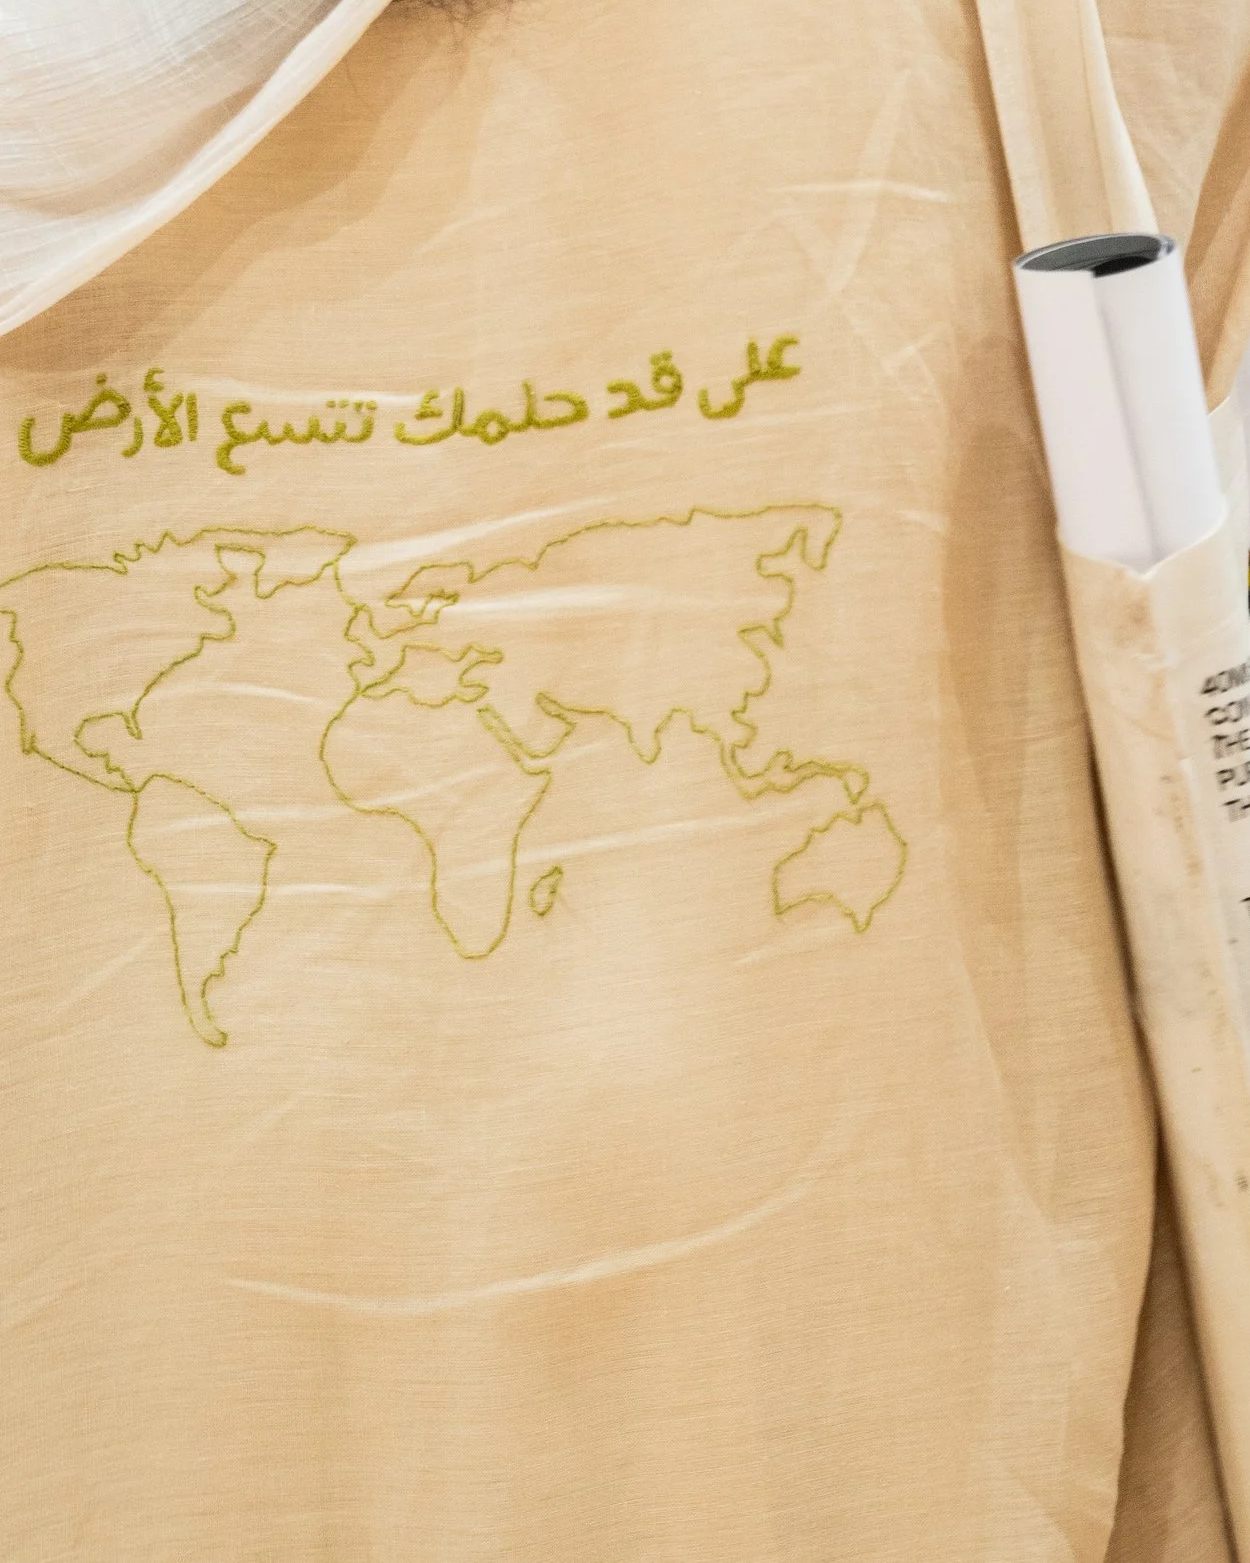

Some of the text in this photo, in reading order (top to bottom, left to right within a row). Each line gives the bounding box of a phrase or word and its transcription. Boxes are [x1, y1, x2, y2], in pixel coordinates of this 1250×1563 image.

[17, 367, 200, 468] الأرض
[394, 380, 590, 446] حلمك
[606, 350, 684, 419] قد
[216, 399, 379, 476] تتسع
